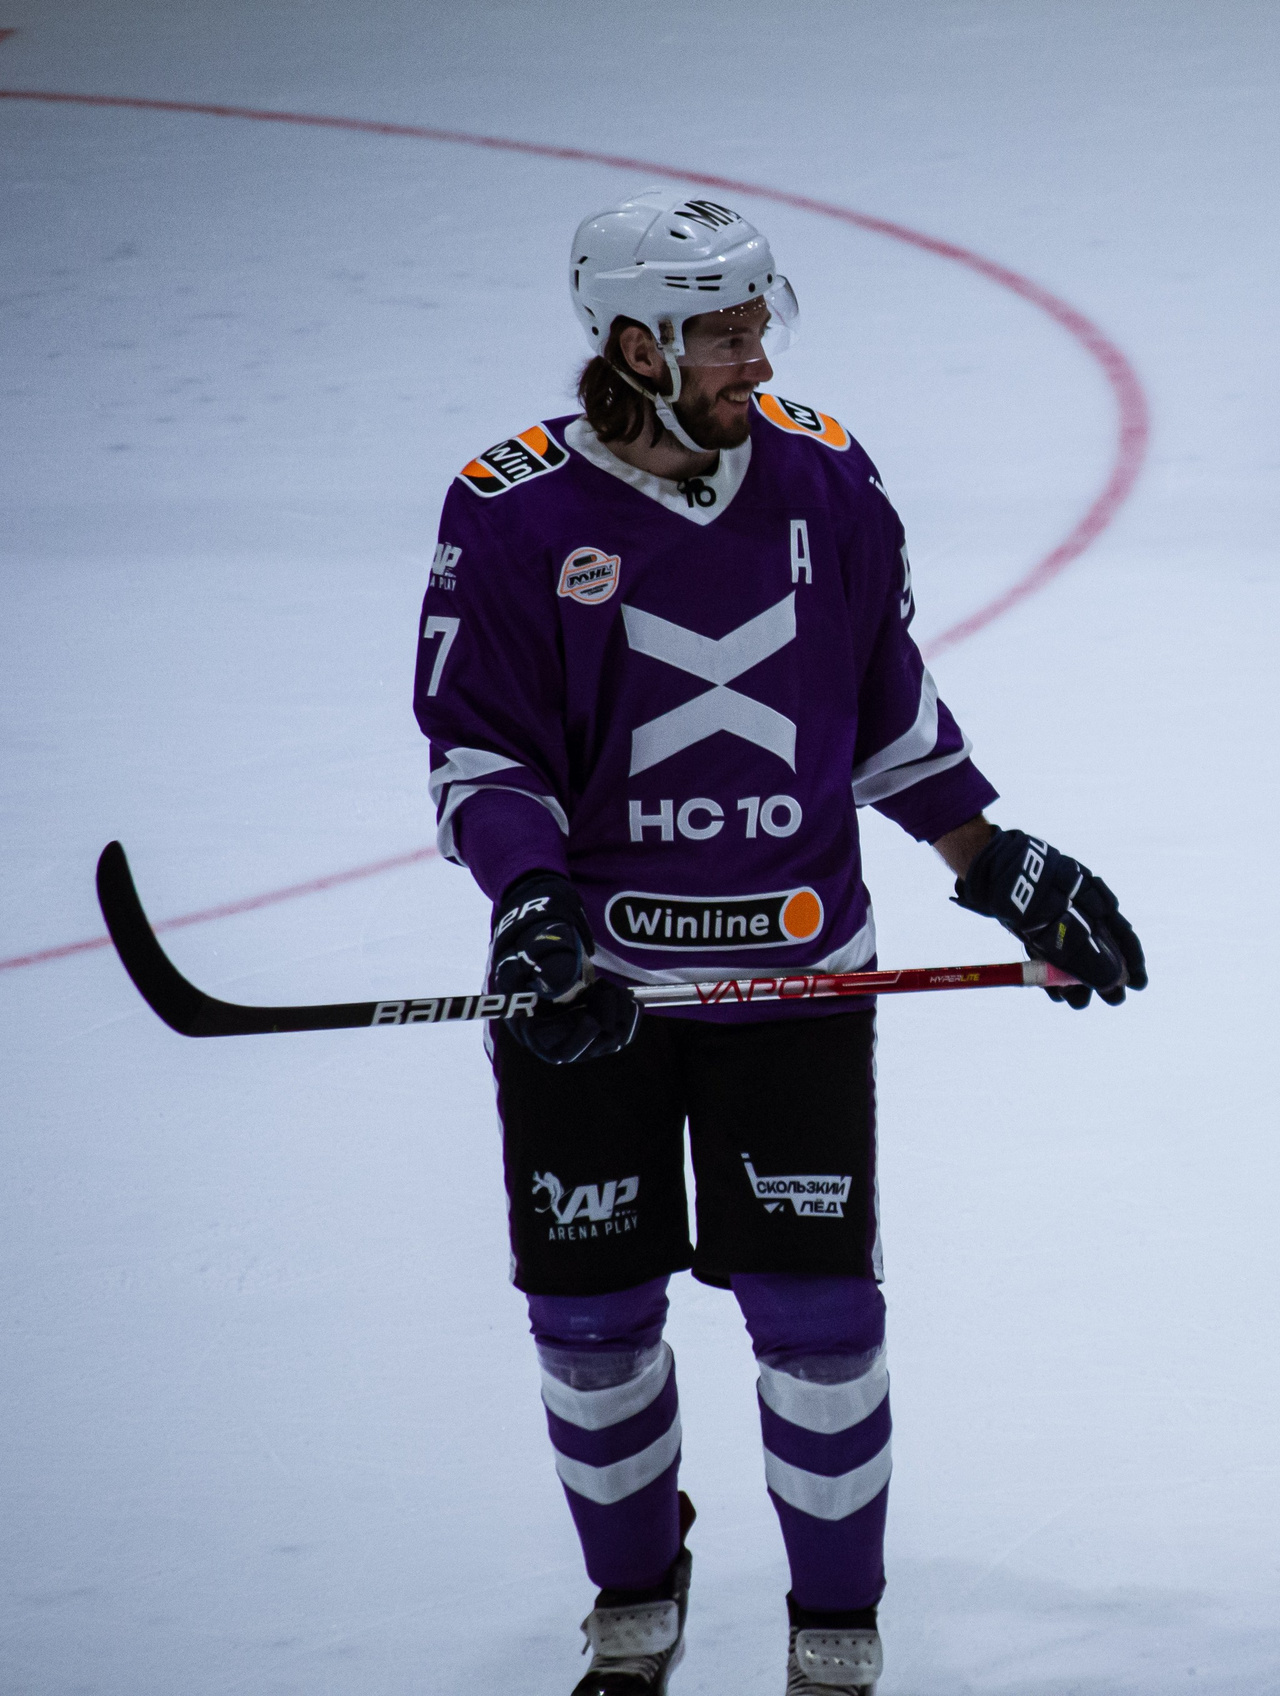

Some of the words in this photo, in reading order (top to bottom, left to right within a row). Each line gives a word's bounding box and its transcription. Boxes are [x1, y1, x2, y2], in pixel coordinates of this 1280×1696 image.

[789, 518, 813, 585] A
[423, 615, 461, 697] 7
[628, 797, 726, 842] HC
[737, 794, 803, 839] 10
[625, 904, 770, 939] Winline
[756, 1178, 846, 1196] СКОЛЬЗКИЙ
[800, 1199, 839, 1214] ЛЁД
[548, 1224, 598, 1241] ARENA
[604, 1216, 639, 1236] PLAY
